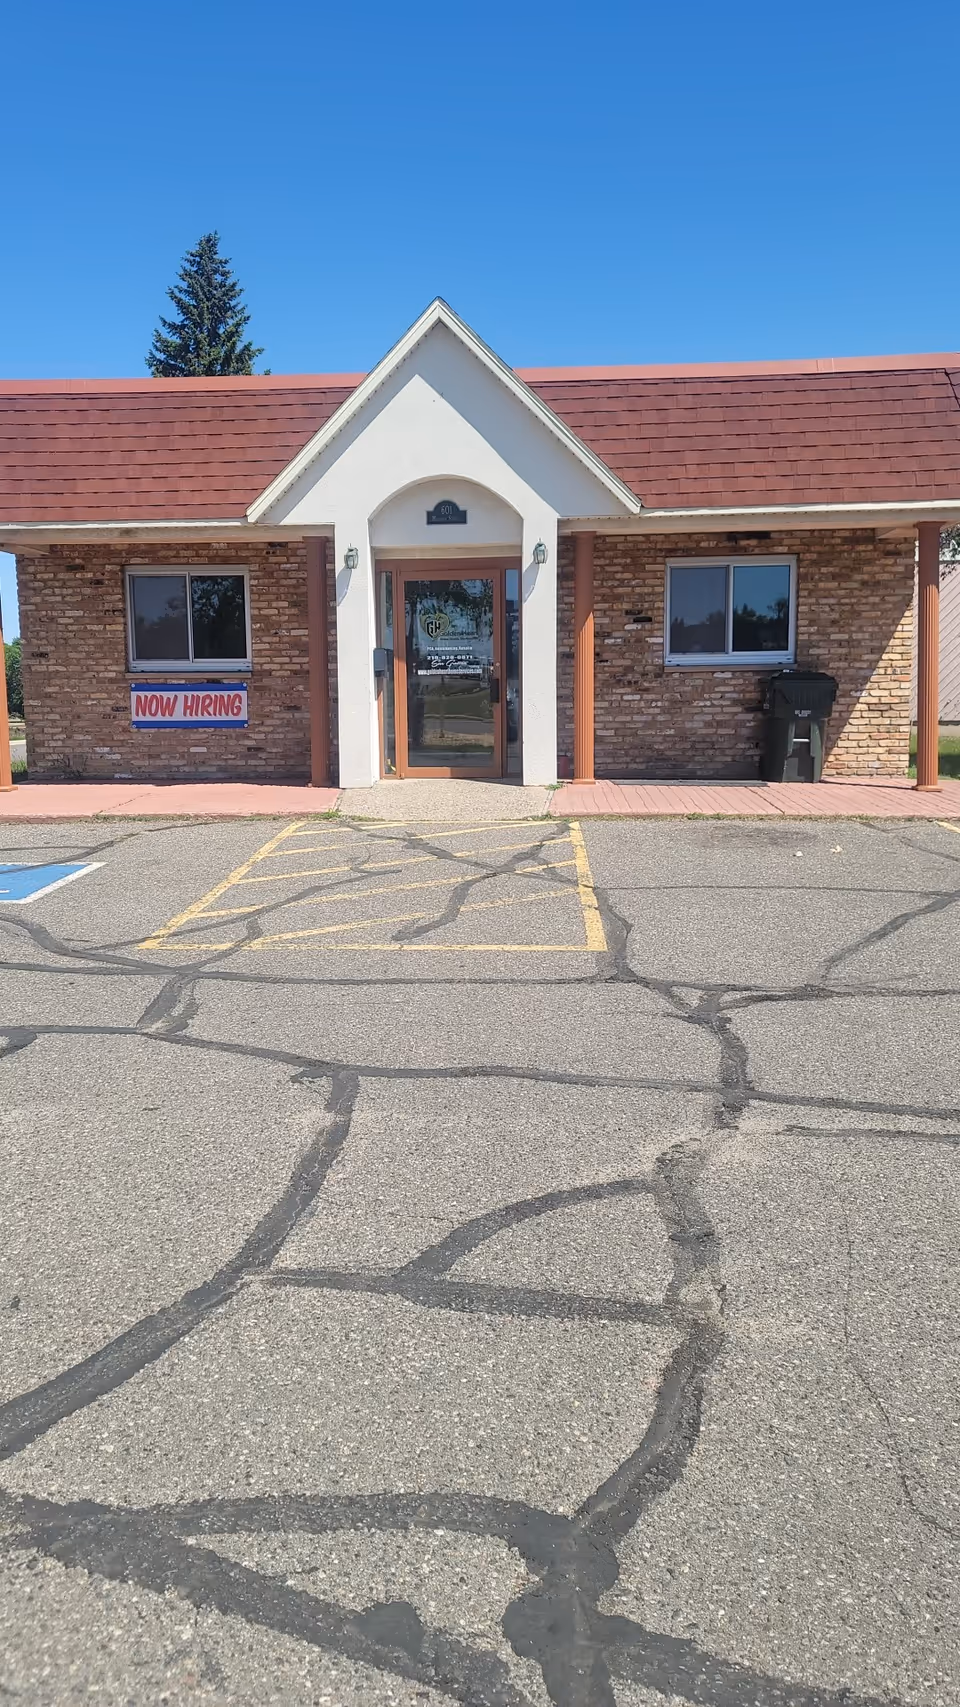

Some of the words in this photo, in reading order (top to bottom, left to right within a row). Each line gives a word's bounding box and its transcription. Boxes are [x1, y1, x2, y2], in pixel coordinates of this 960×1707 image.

[441, 505, 452, 514] 601
[135, 694, 178, 717] NOW
[183, 693, 242, 717] HIRING
